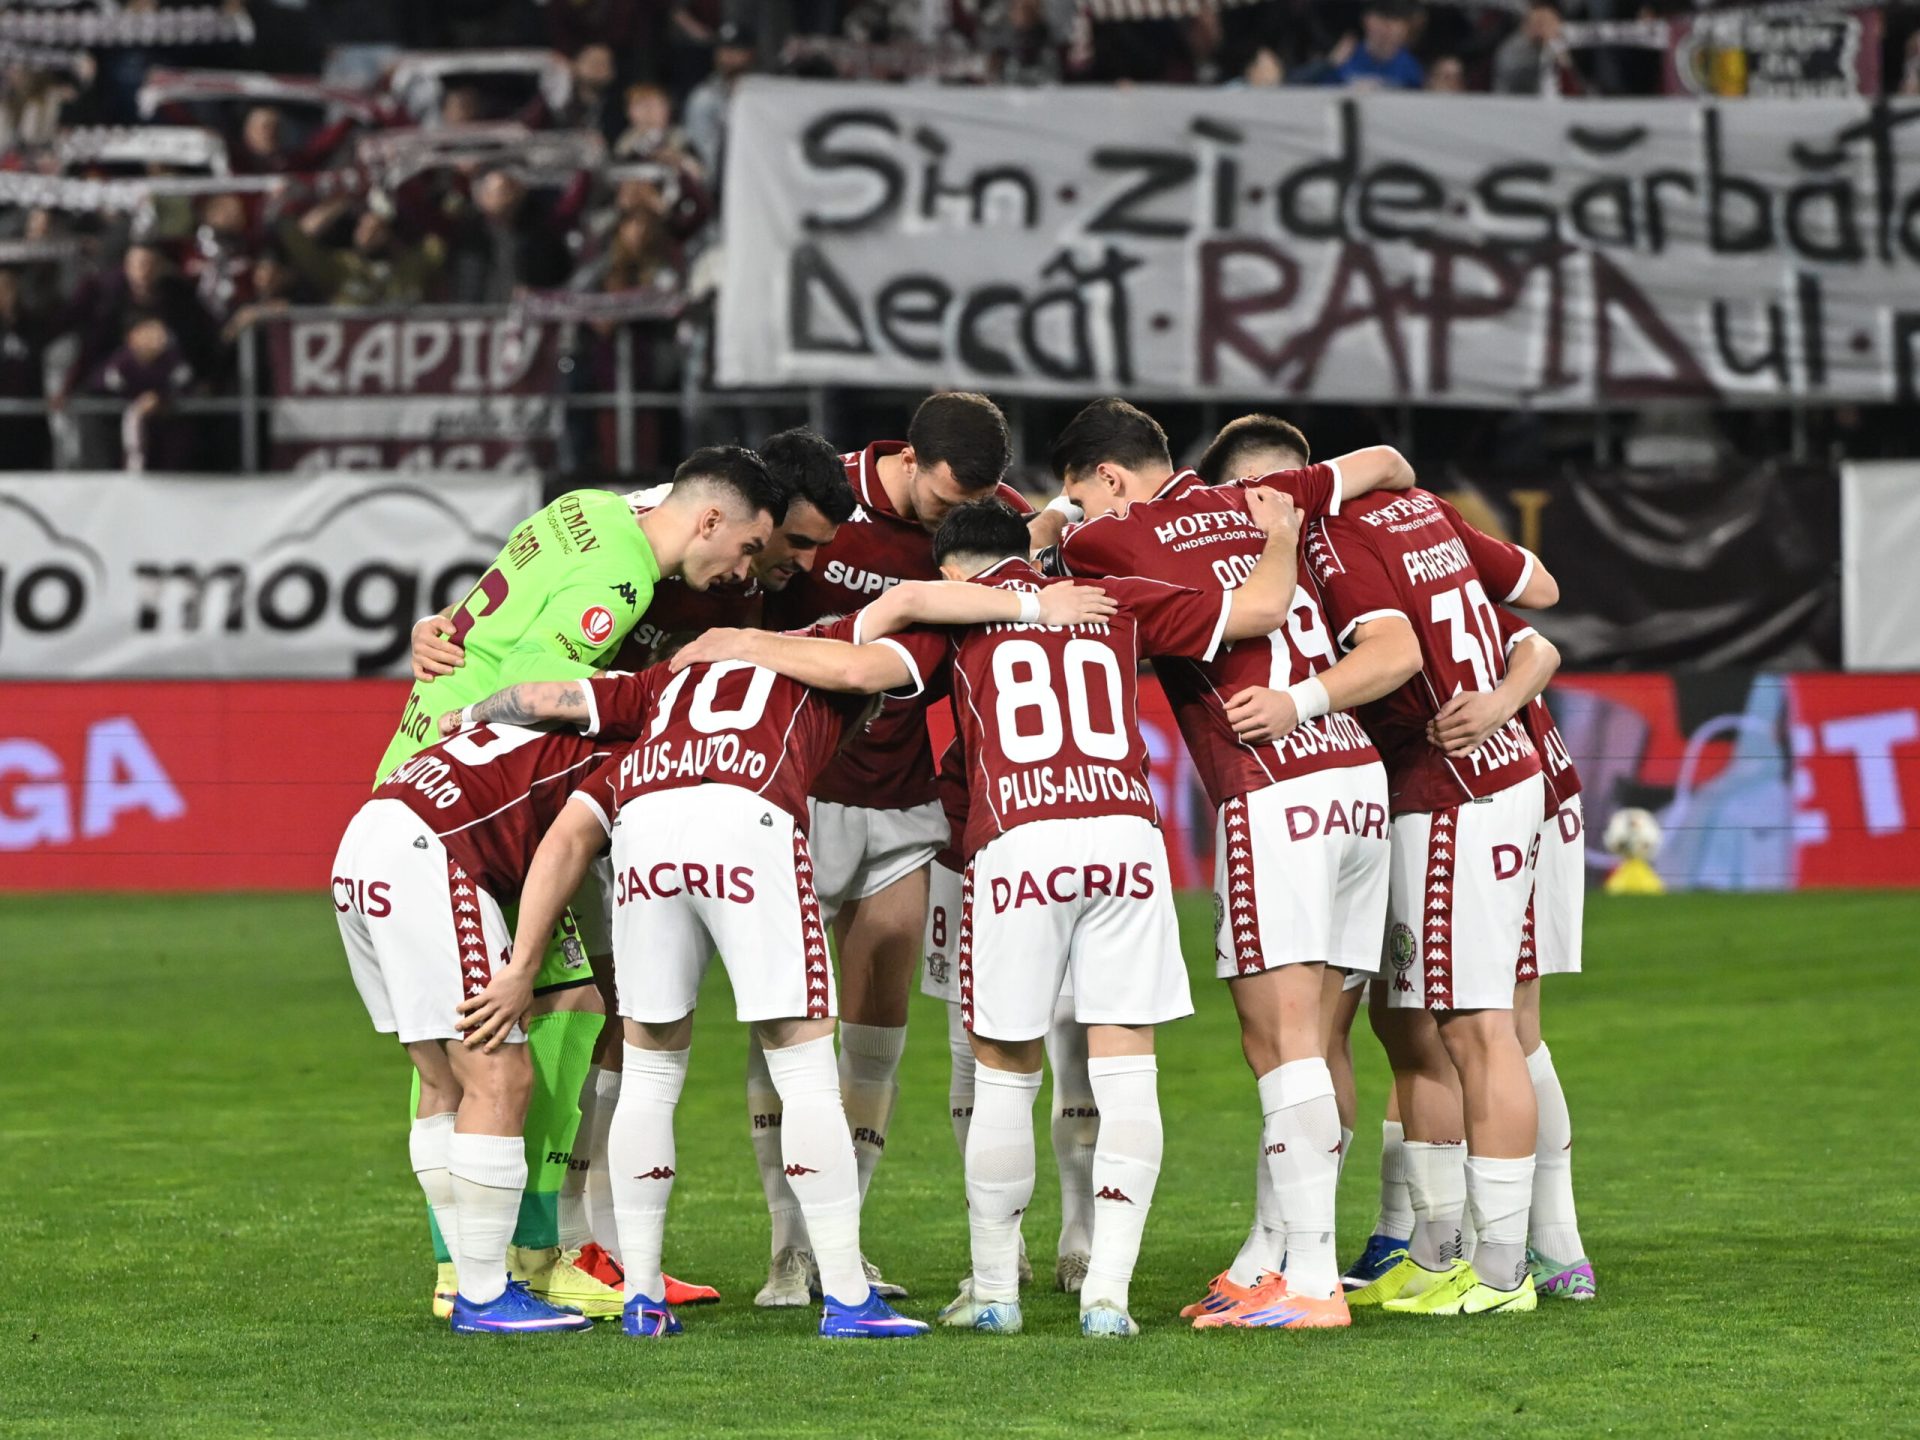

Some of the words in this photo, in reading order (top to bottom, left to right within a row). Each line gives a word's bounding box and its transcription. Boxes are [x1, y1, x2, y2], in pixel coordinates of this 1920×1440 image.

[1172, 530, 1247, 552] UNDERFLOOR
[824, 560, 912, 595] SUPE
[991, 638, 1130, 764] 80
[620, 733, 767, 792] PLUS-AUTO.ro
[1284, 799, 1391, 843] DACR
[990, 862, 1155, 915] DACRIS
[932, 905, 947, 948] 8
[754, 1114, 767, 1129] FC
[1062, 1107, 1075, 1118] FC
[854, 1127, 868, 1141] FC
